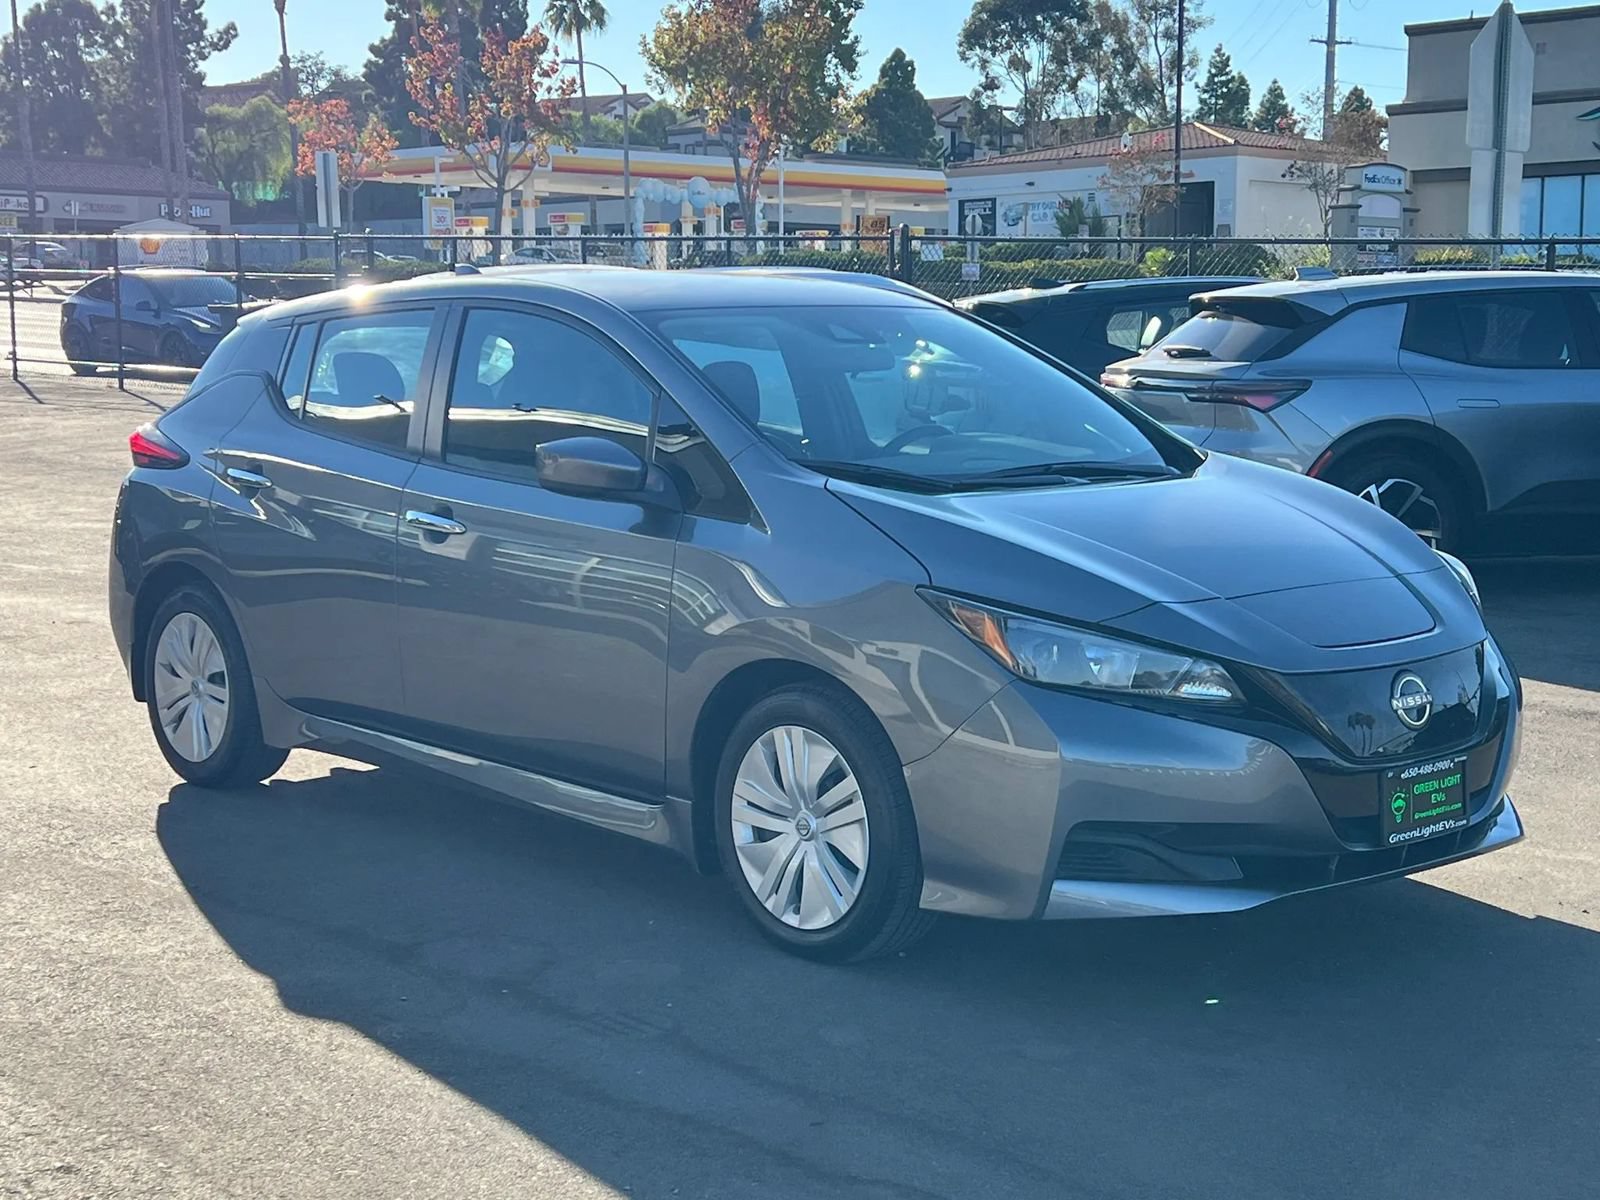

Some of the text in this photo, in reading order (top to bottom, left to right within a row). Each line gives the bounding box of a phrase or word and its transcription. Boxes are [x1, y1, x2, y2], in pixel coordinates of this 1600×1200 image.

[1391, 693, 1432, 711] NISSAN
[1413, 774, 1462, 795] GREEN LIGHT
[1431, 792, 1446, 804] EVs
[1389, 819, 1467, 844] GreenLightEVs.com
